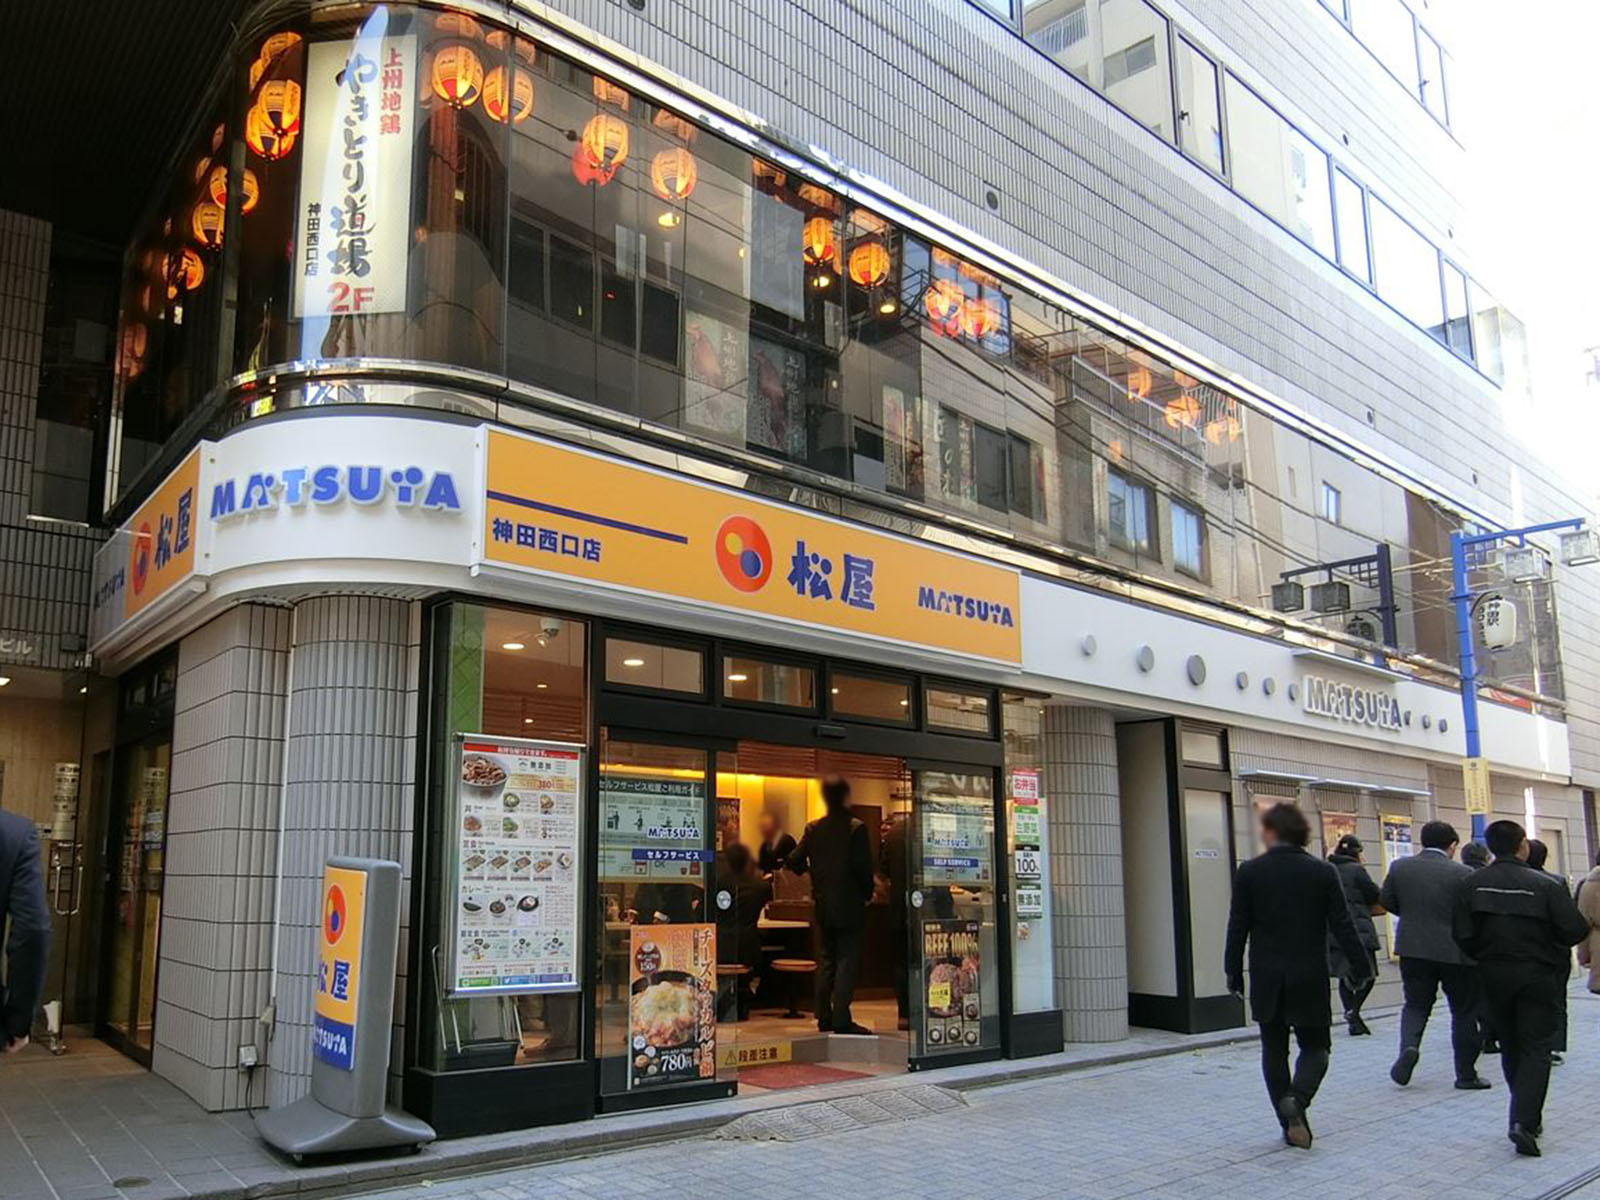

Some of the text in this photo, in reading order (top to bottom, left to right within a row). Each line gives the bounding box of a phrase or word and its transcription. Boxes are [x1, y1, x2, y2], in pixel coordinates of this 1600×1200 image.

[380, 48, 403, 134] 上州地鶏
[327, 53, 377, 278] やきとり道場
[304, 202, 322, 277] 神田西口店
[327, 282, 375, 312] 2F
[210, 466, 461, 519] MATSUYA
[155, 487, 193, 571] 松屋
[492, 516, 601, 562] 神田西口店
[787, 540, 876, 611] 松屋
[917, 585, 1014, 628] MATSUYA
[1303, 675, 1403, 731] MATSUYA
[647, 851, 700, 860] セルフサービス
[648, 827, 700, 838] MATSUYA
